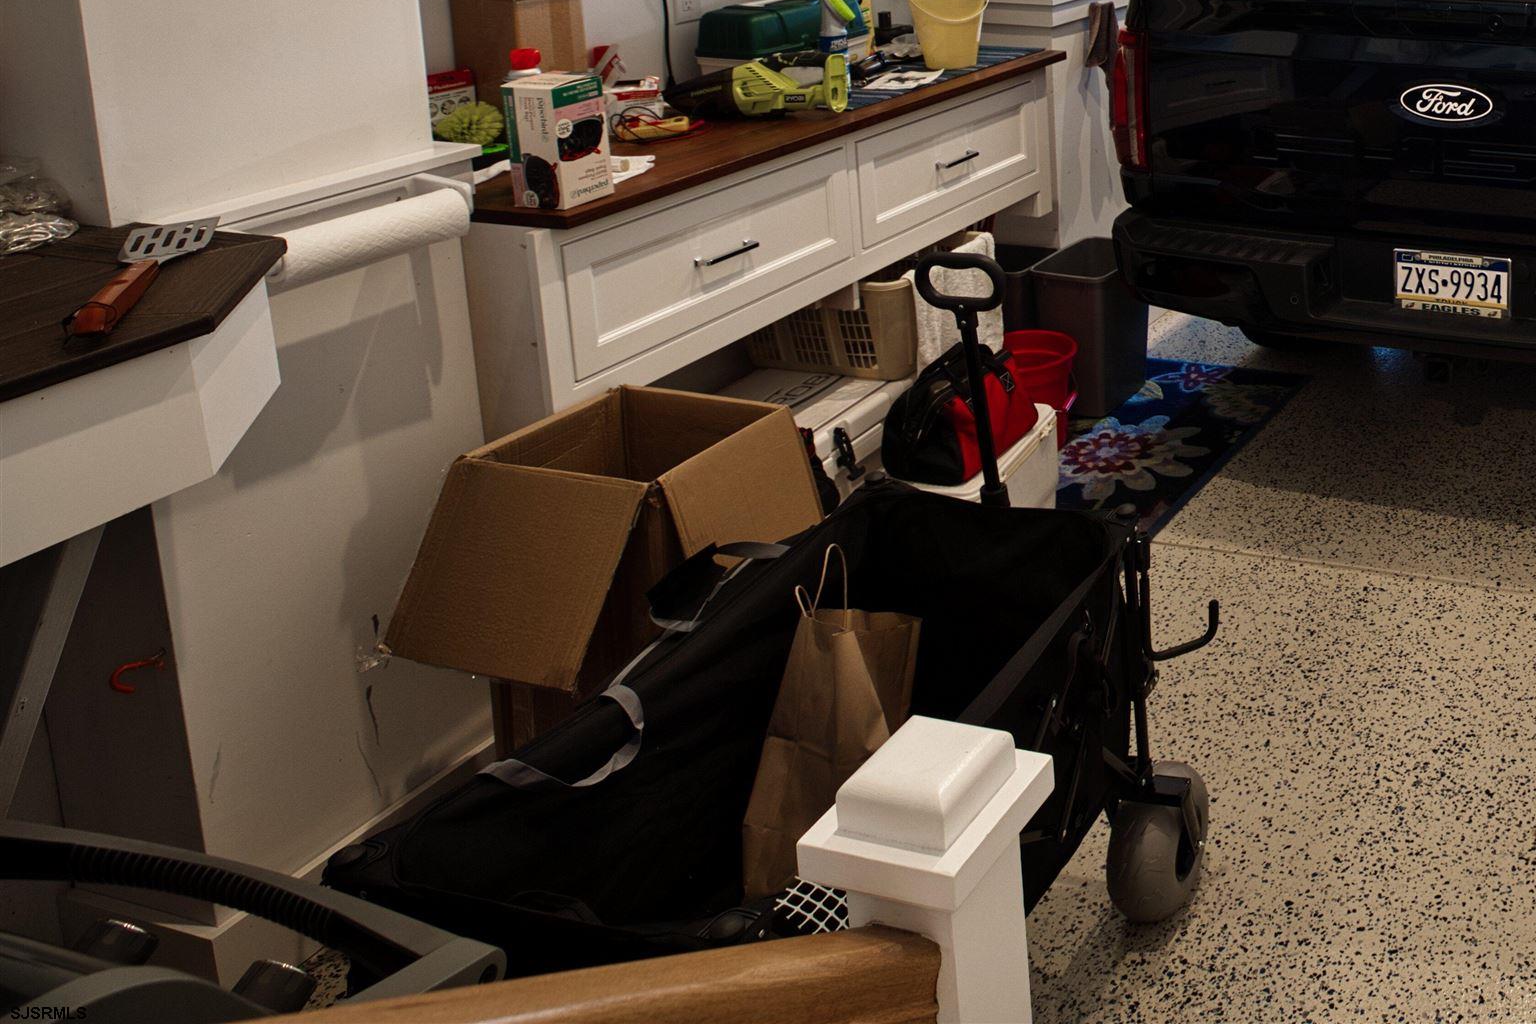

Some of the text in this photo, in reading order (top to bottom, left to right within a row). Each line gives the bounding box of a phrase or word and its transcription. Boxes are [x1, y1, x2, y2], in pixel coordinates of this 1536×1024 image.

[1416, 87, 1476, 117] Ford
[1428, 255, 1474, 264] PHILADELPHIA
[1421, 302, 1481, 317] EAGLES
